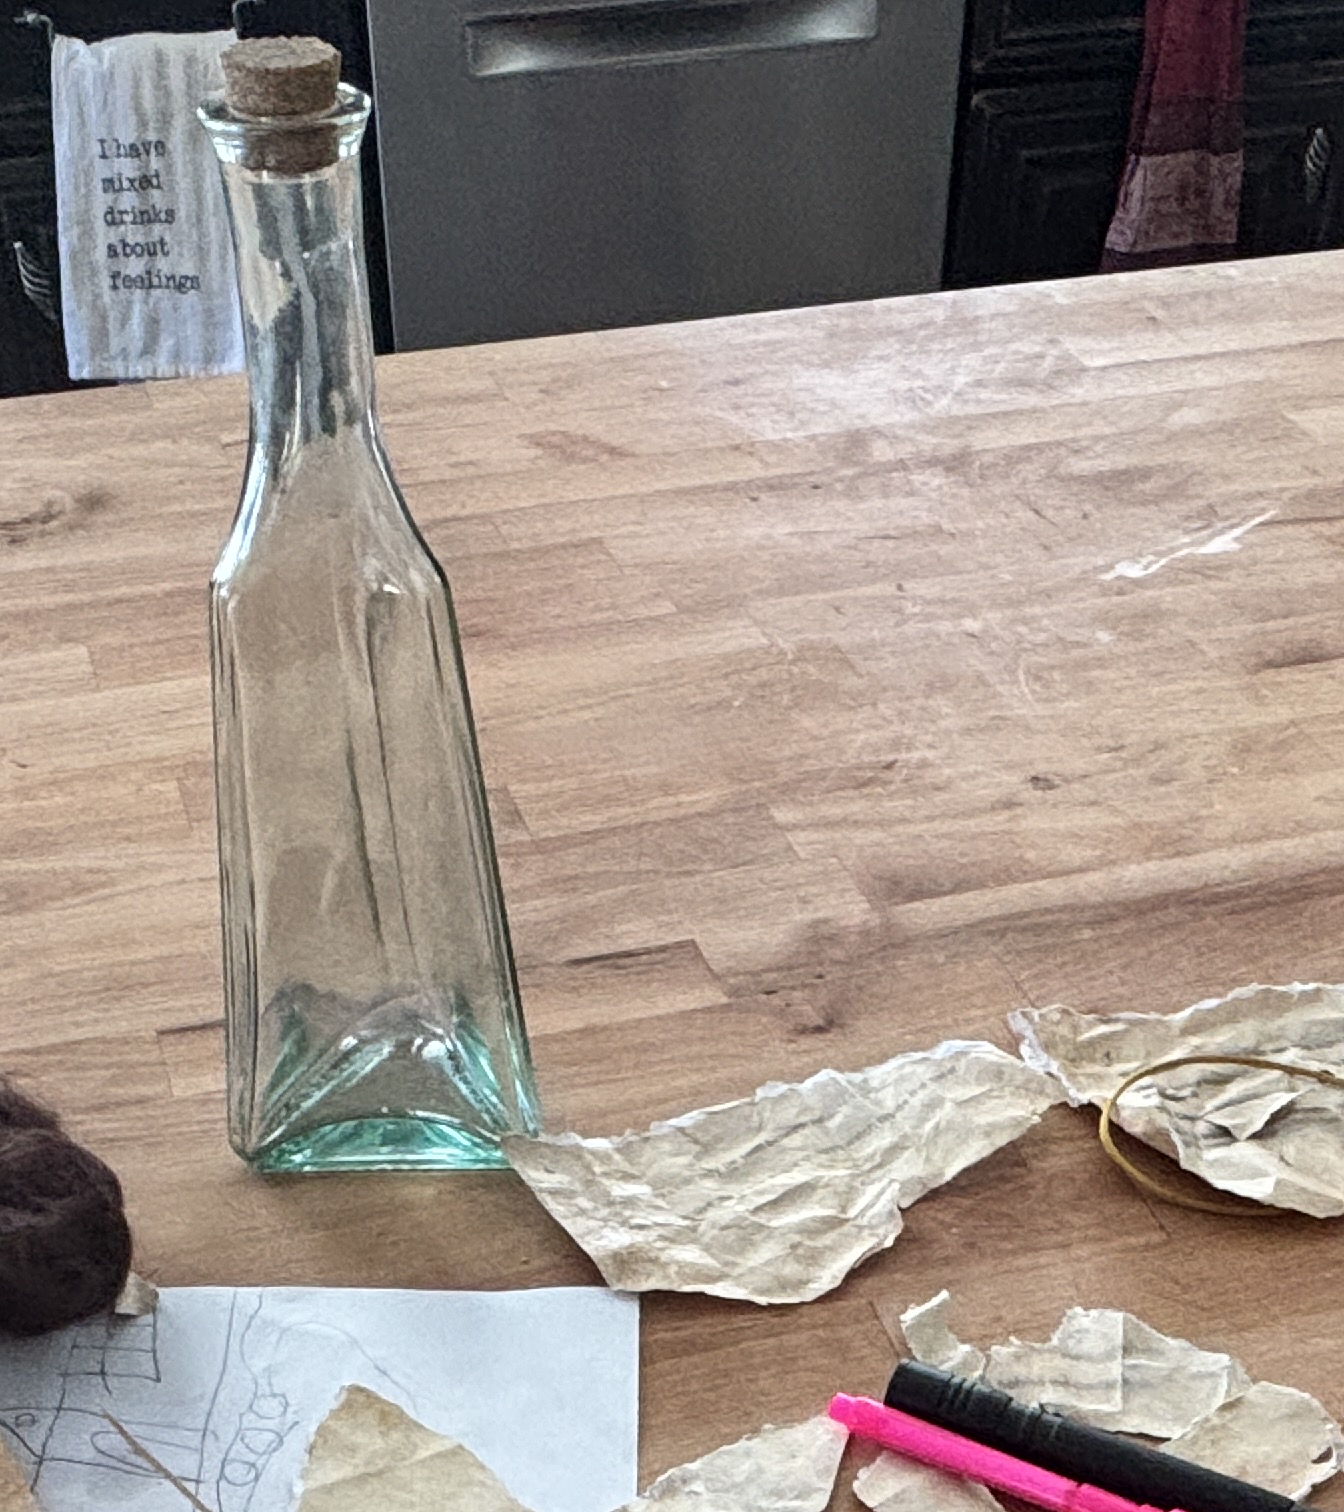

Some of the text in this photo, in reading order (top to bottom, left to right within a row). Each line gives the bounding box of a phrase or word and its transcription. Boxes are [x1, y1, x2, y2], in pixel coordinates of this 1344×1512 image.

[109, 139, 167, 158] have
[100, 170, 162, 192] mixed
[103, 205, 176, 225] drinks
[106, 238, 170, 258] about
[108, 269, 201, 294] feelings
